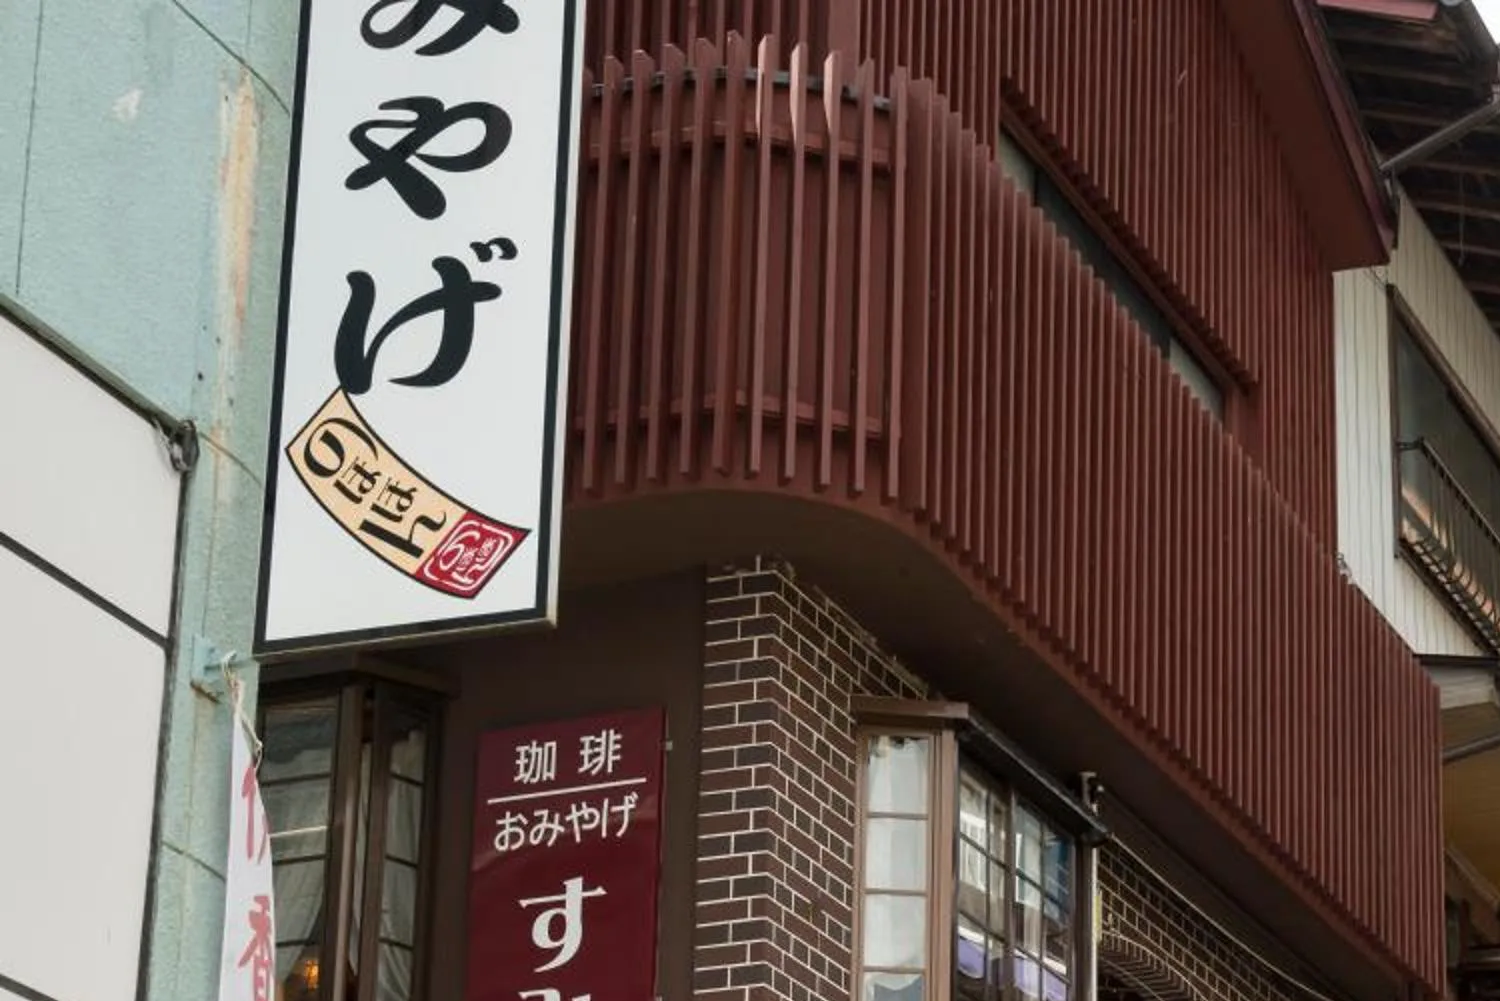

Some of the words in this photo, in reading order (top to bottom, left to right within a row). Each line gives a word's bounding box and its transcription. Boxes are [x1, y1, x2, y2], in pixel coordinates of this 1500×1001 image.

[513, 729, 623, 785] 珈琲
[493, 791, 639, 852] おみやげ
